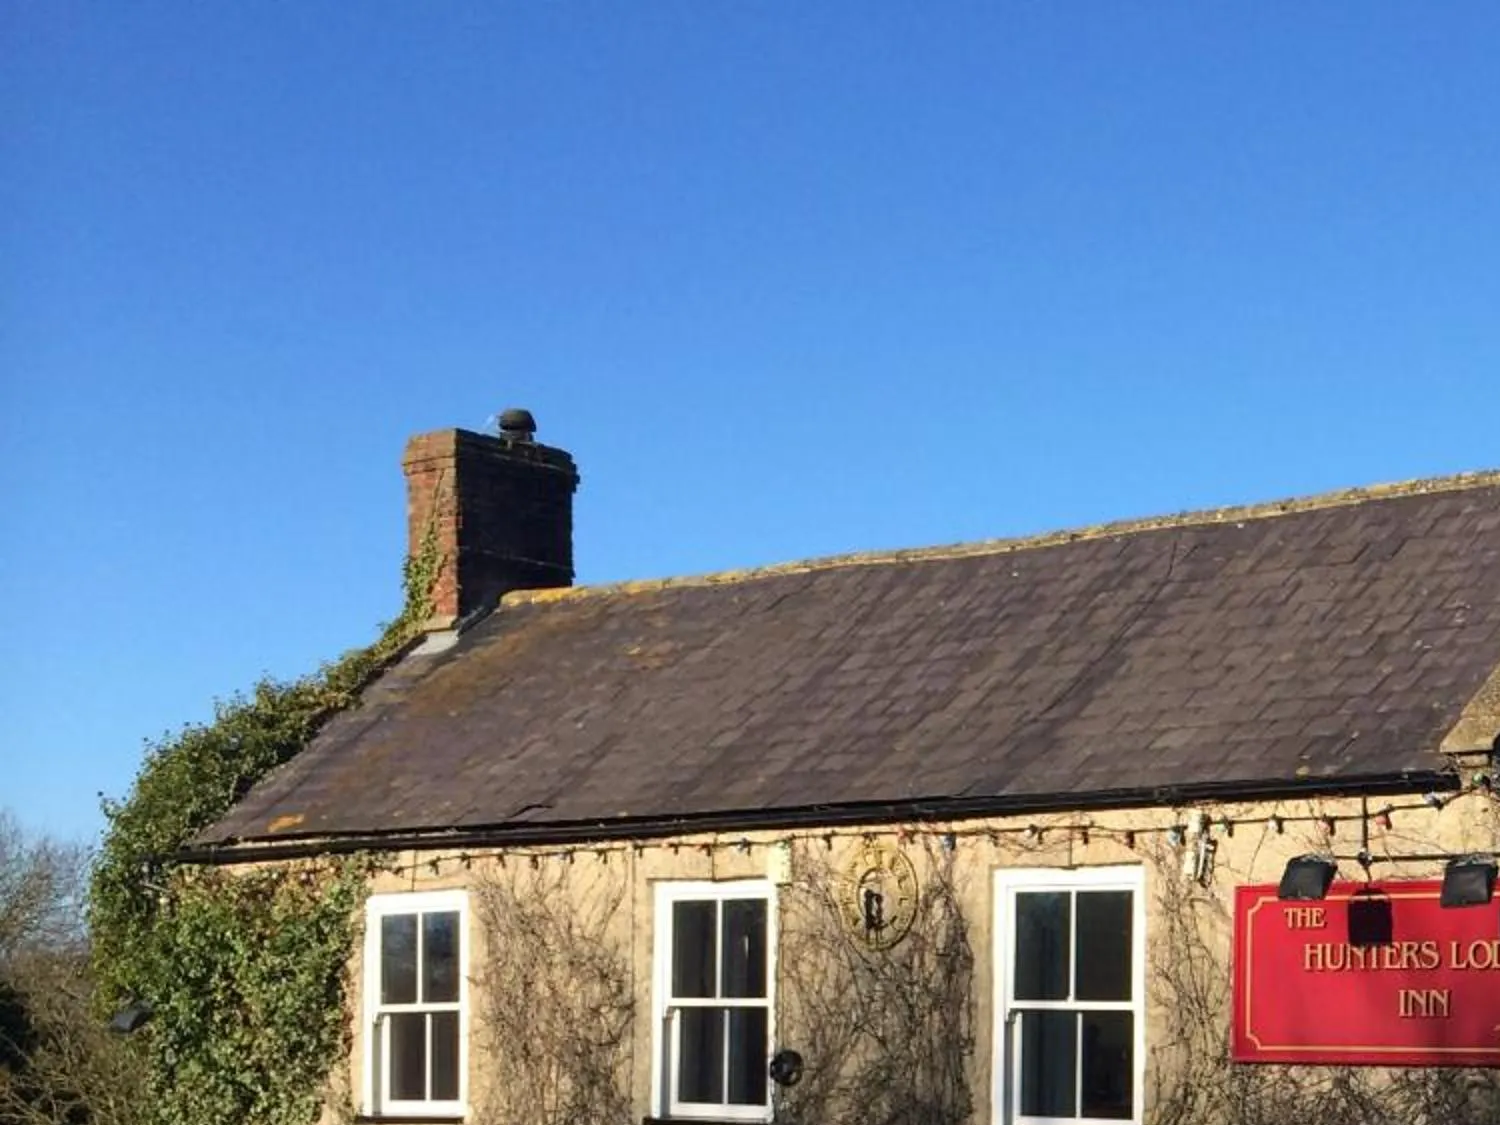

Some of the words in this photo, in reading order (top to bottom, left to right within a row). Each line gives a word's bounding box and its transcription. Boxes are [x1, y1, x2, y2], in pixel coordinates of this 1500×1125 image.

[1284, 908, 1326, 928] THE
[1304, 941, 1440, 970] HUNTERS
[1399, 989, 1450, 1018] INN
